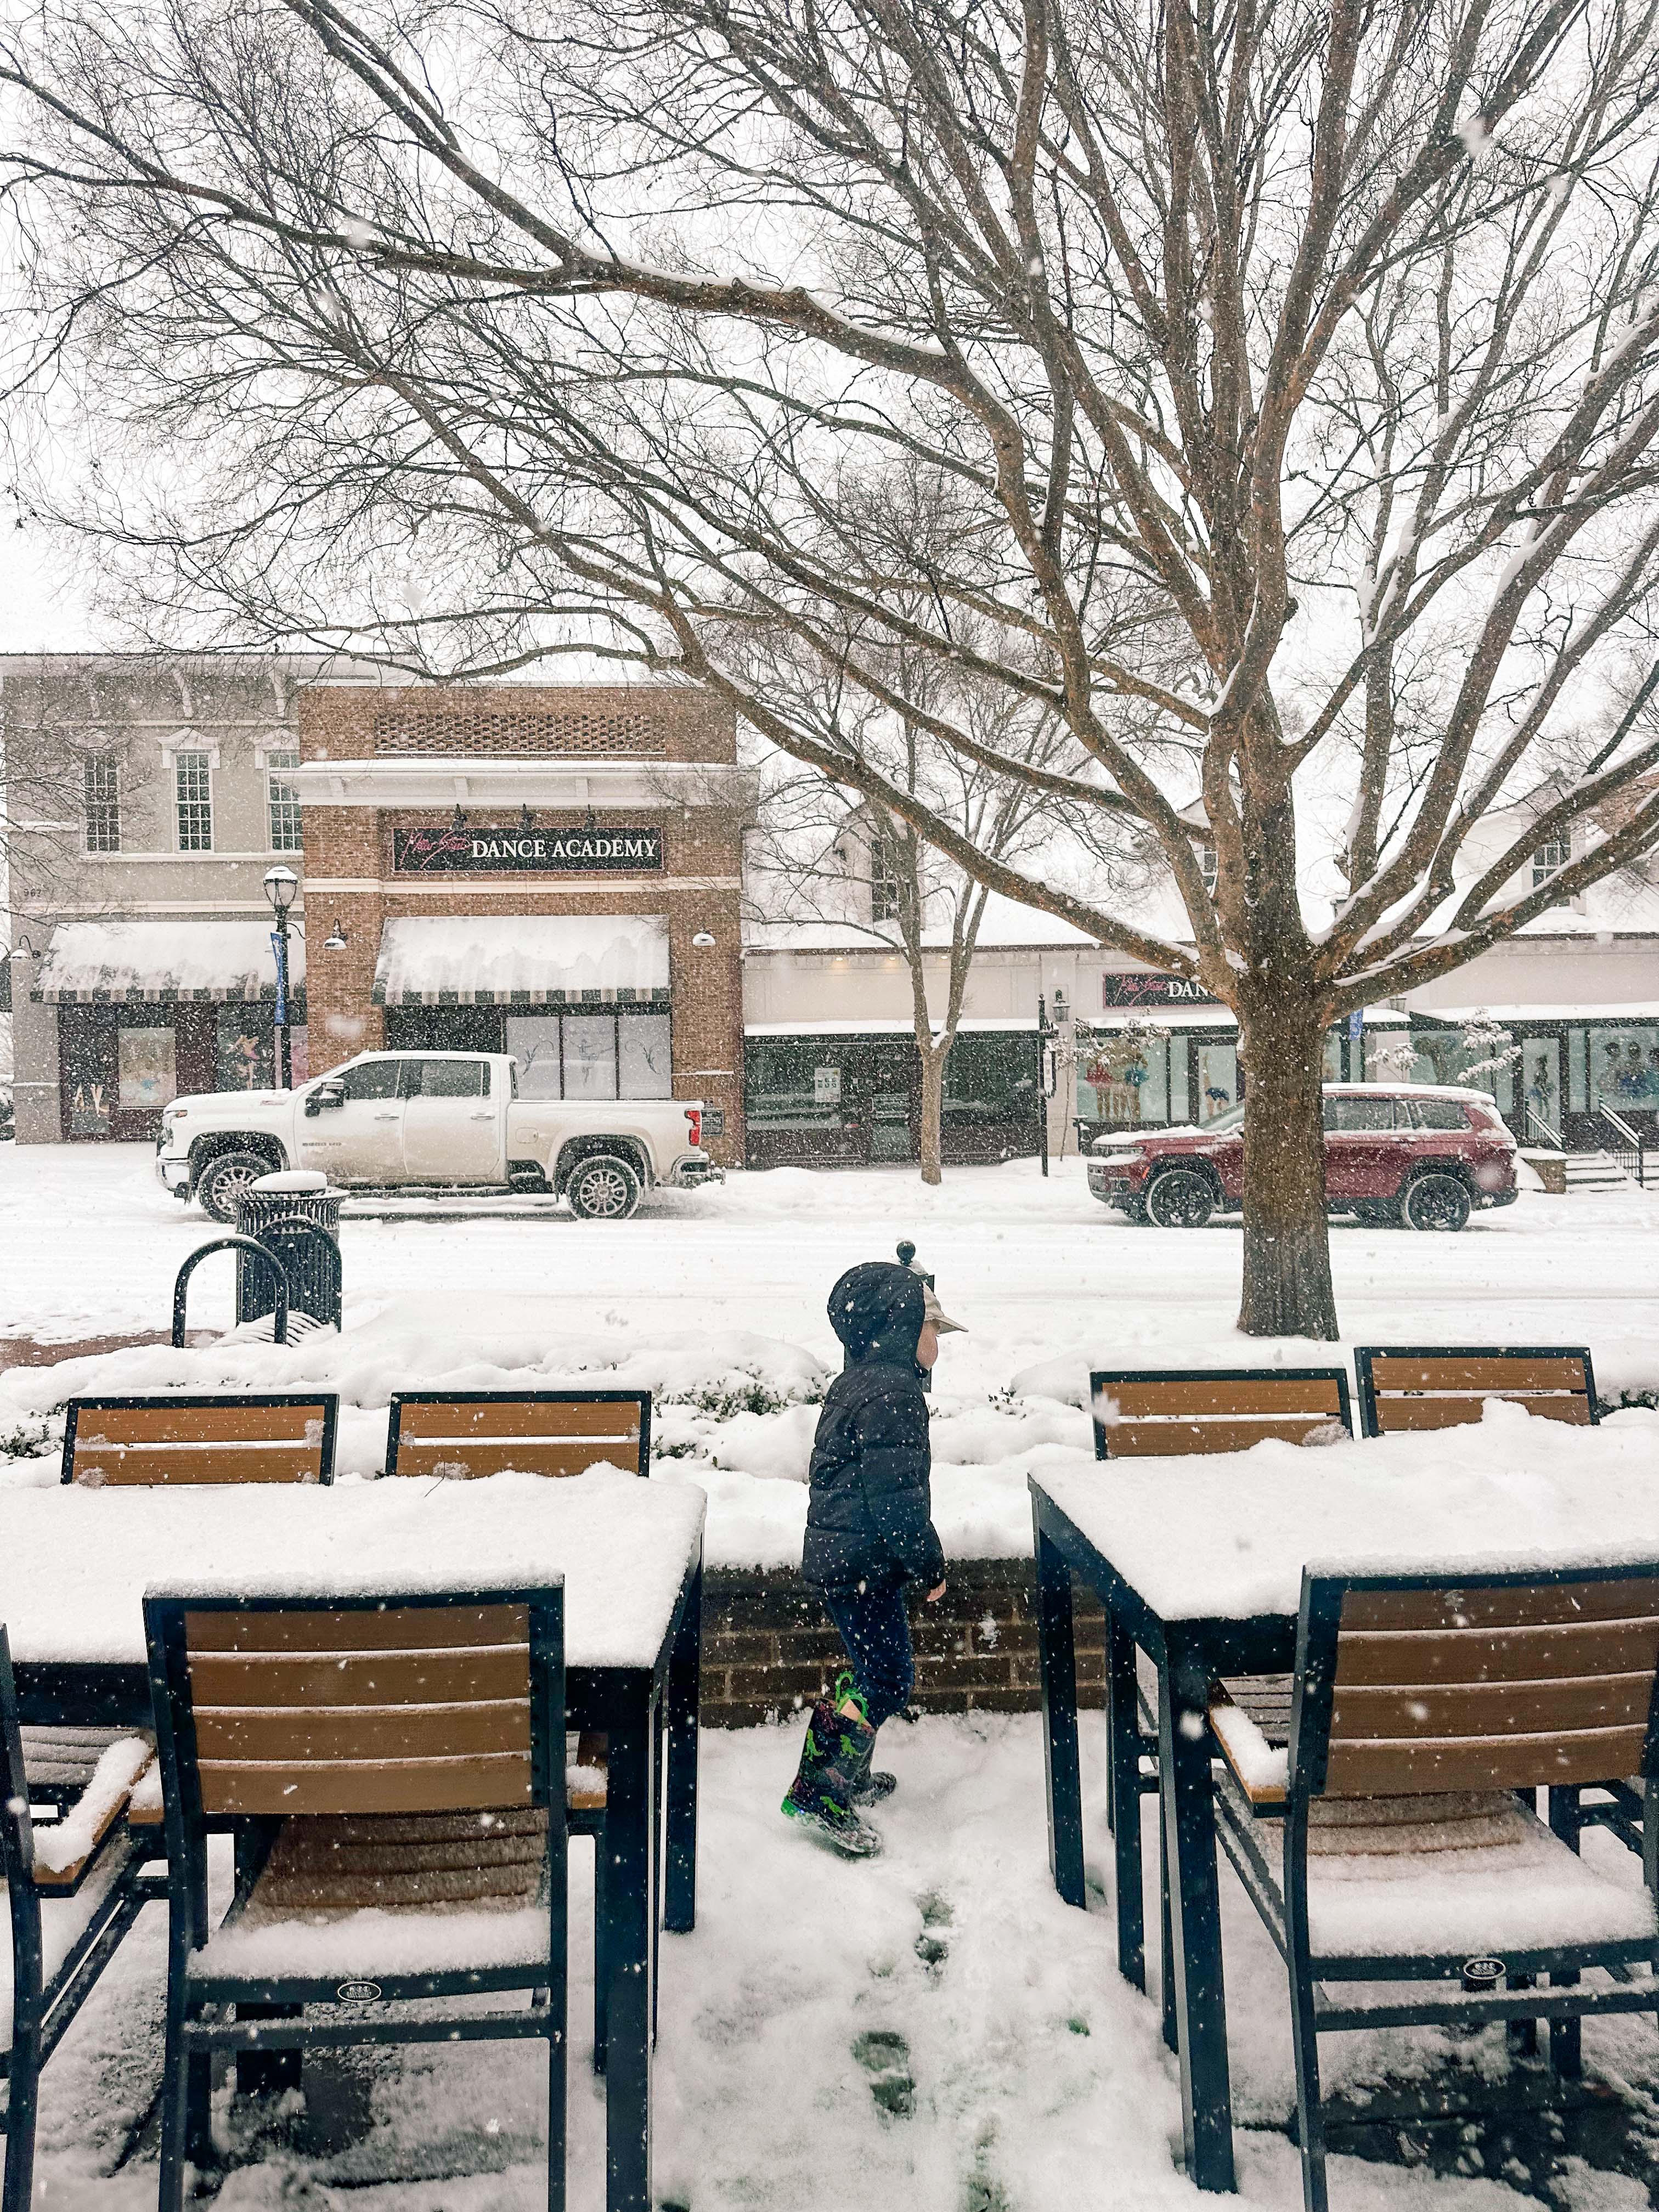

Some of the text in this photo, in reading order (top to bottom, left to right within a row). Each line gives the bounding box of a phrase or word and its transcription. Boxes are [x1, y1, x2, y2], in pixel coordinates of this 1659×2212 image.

[472, 839, 546, 857] DANCE
[551, 839, 657, 857] ACADEMY
[1168, 981, 1216, 997] DAN
